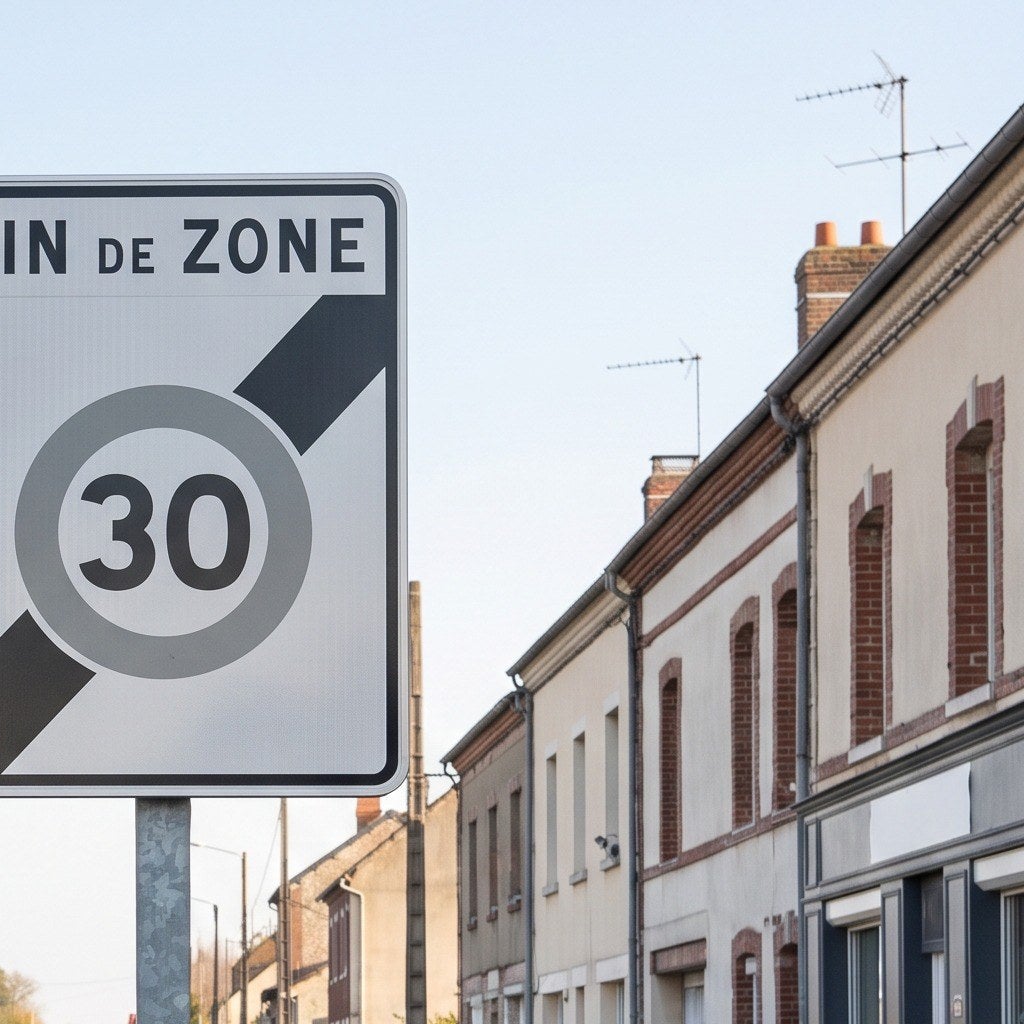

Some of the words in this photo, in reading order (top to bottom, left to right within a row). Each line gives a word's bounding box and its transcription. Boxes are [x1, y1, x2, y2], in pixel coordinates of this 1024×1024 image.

[98, 237, 155, 274] DE
[182, 217, 365, 274] ZONE
[78, 473, 251, 591] 30
